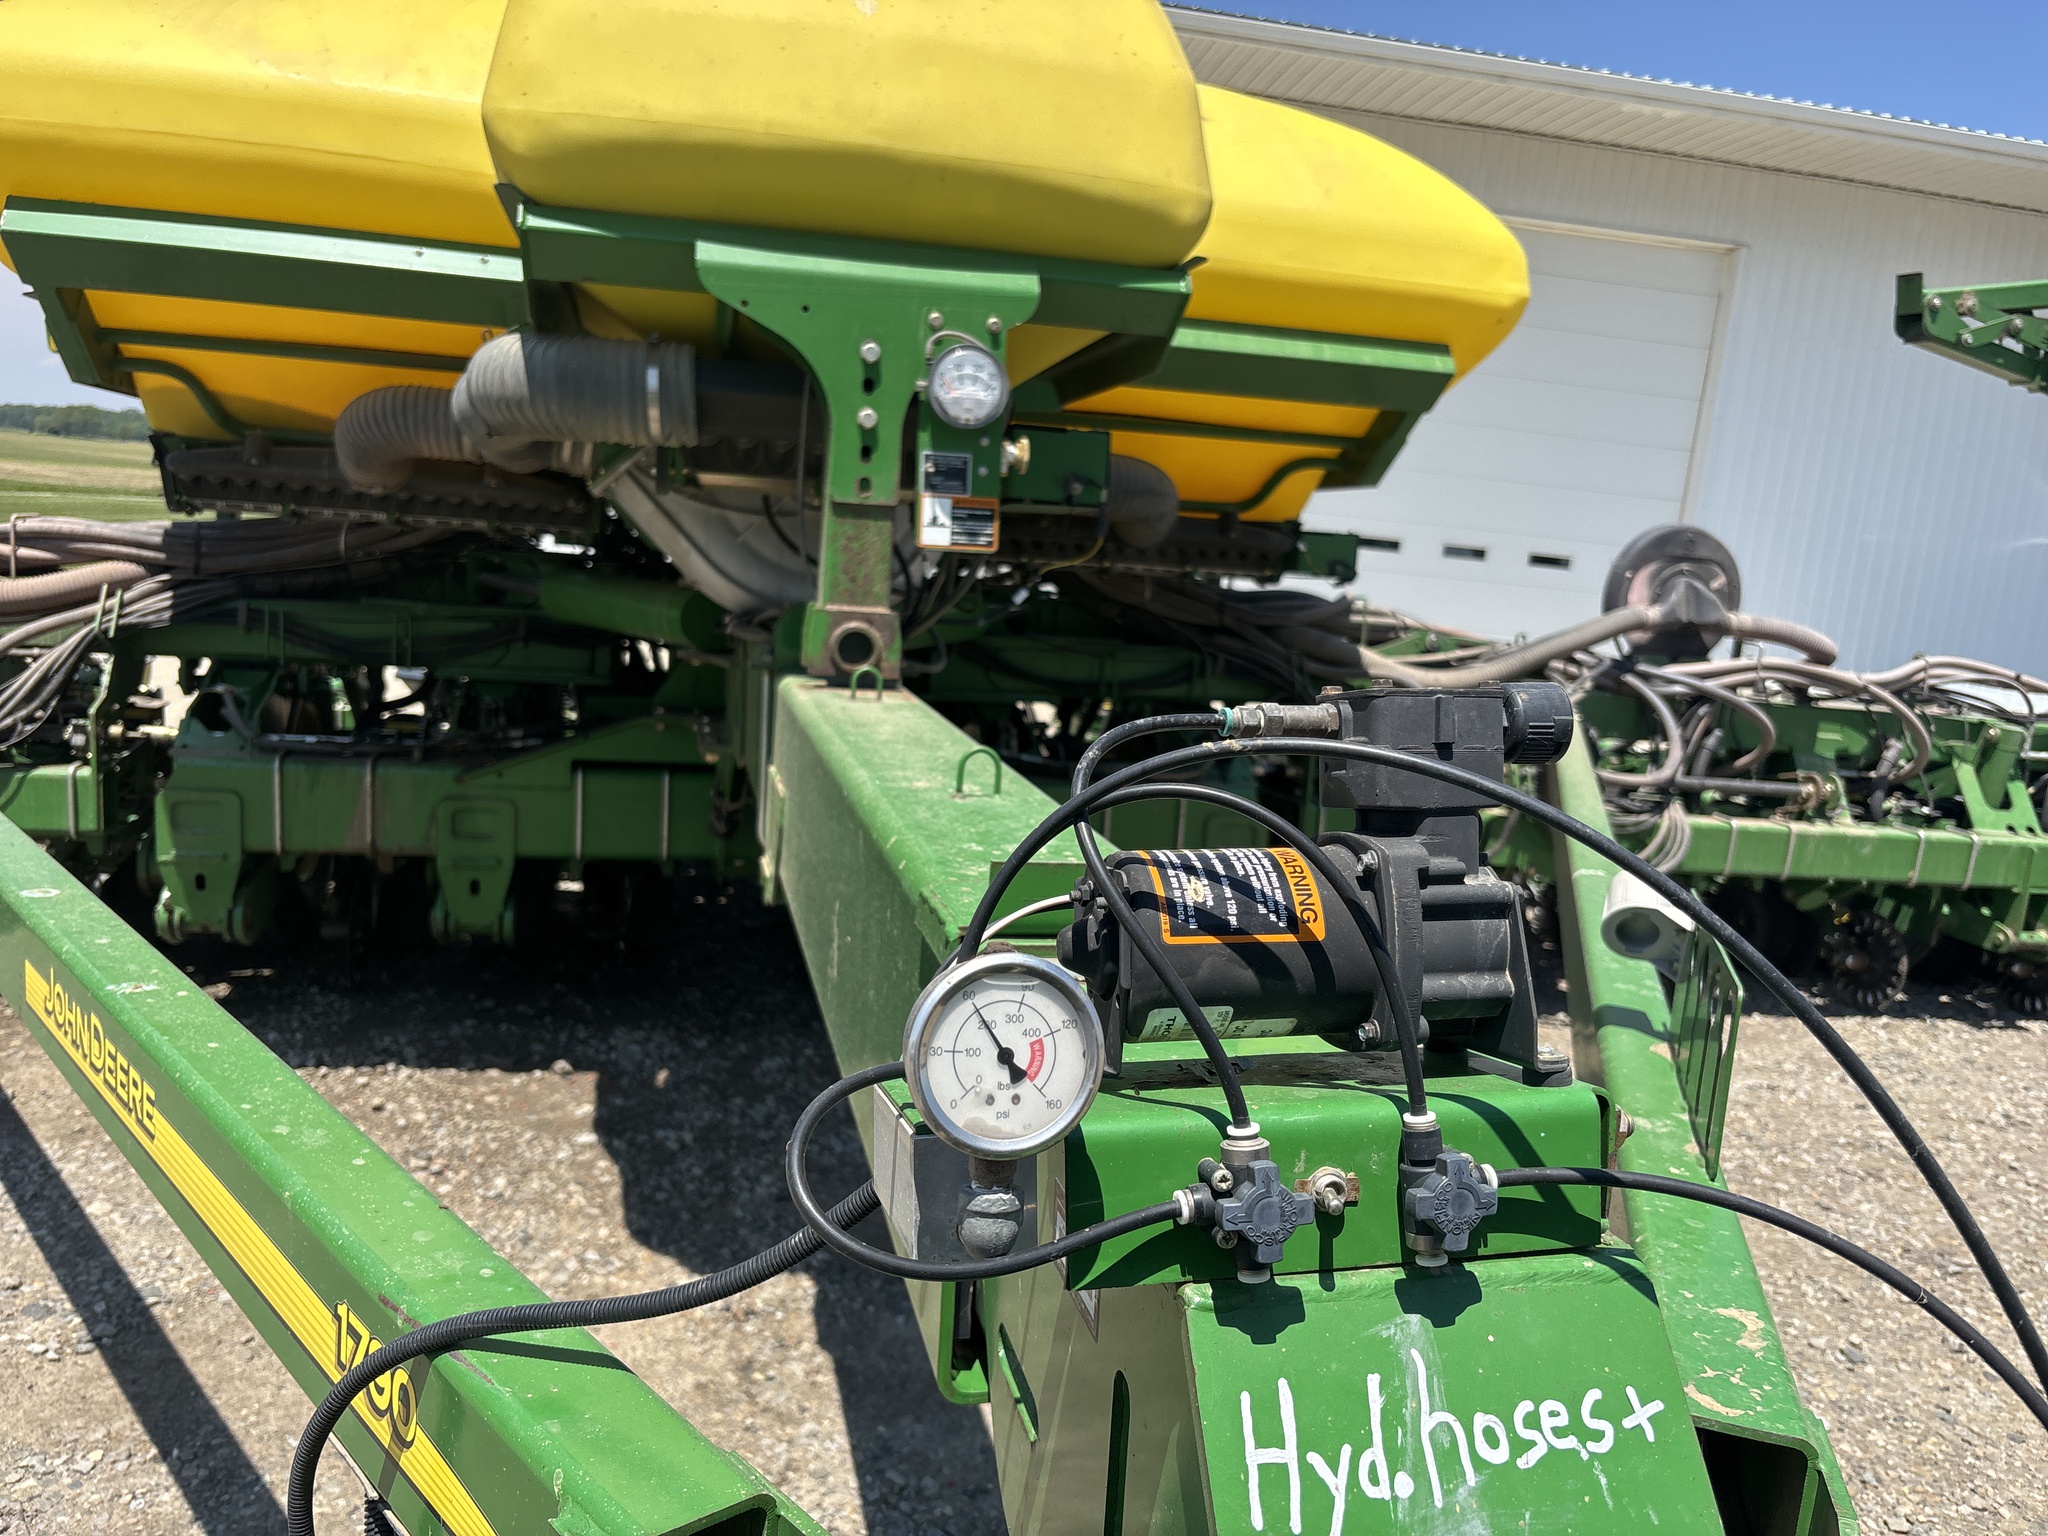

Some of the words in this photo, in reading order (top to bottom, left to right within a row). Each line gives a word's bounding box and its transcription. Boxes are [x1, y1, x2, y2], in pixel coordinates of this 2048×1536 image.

[1169, 876, 1180, 888] are
[1268, 872, 1281, 887] from
[1220, 876, 1233, 896] above
[1274, 850, 1319, 925] WARNING
[1203, 886, 1216, 908] valve.
[1250, 875, 1264, 901] without
[1257, 903, 1267, 913] all
[1174, 898, 1187, 922] place.
[1226, 899, 1237, 913] 120
[1273, 889, 1288, 926] exploding
[1188, 917, 1197, 928] all
[1228, 915, 1239, 931] psi.
[1269, 913, 1277, 921] or
[1020, 980, 1035, 991] 90
[962, 990, 976, 1000] 60
[977, 1020, 997, 1030] 200
[1004, 1014, 1025, 1024] 300
[1061, 1019, 1078, 1029] 120
[1021, 1027, 1042, 1038] 400
[45, 967, 88, 1060] JOHN
[89, 1010, 156, 1144] DEERE
[929, 1046, 943, 1056] 30
[965, 1047, 981, 1057] 100
[1027, 1042, 1043, 1077] WARNING
[975, 1074, 983, 1084] 0
[997, 1081, 1011, 1091] lbs
[950, 1099, 958, 1109] 0
[1045, 1099, 1062, 1109] 160
[996, 1109, 1010, 1121] psi
[1434, 1181, 1453, 1224] PISCO
[1442, 1211, 1482, 1235] NIHON
[1245, 1225, 1286, 1247] PISCO
[1240, 1372, 1415, 1536] Hyd.
